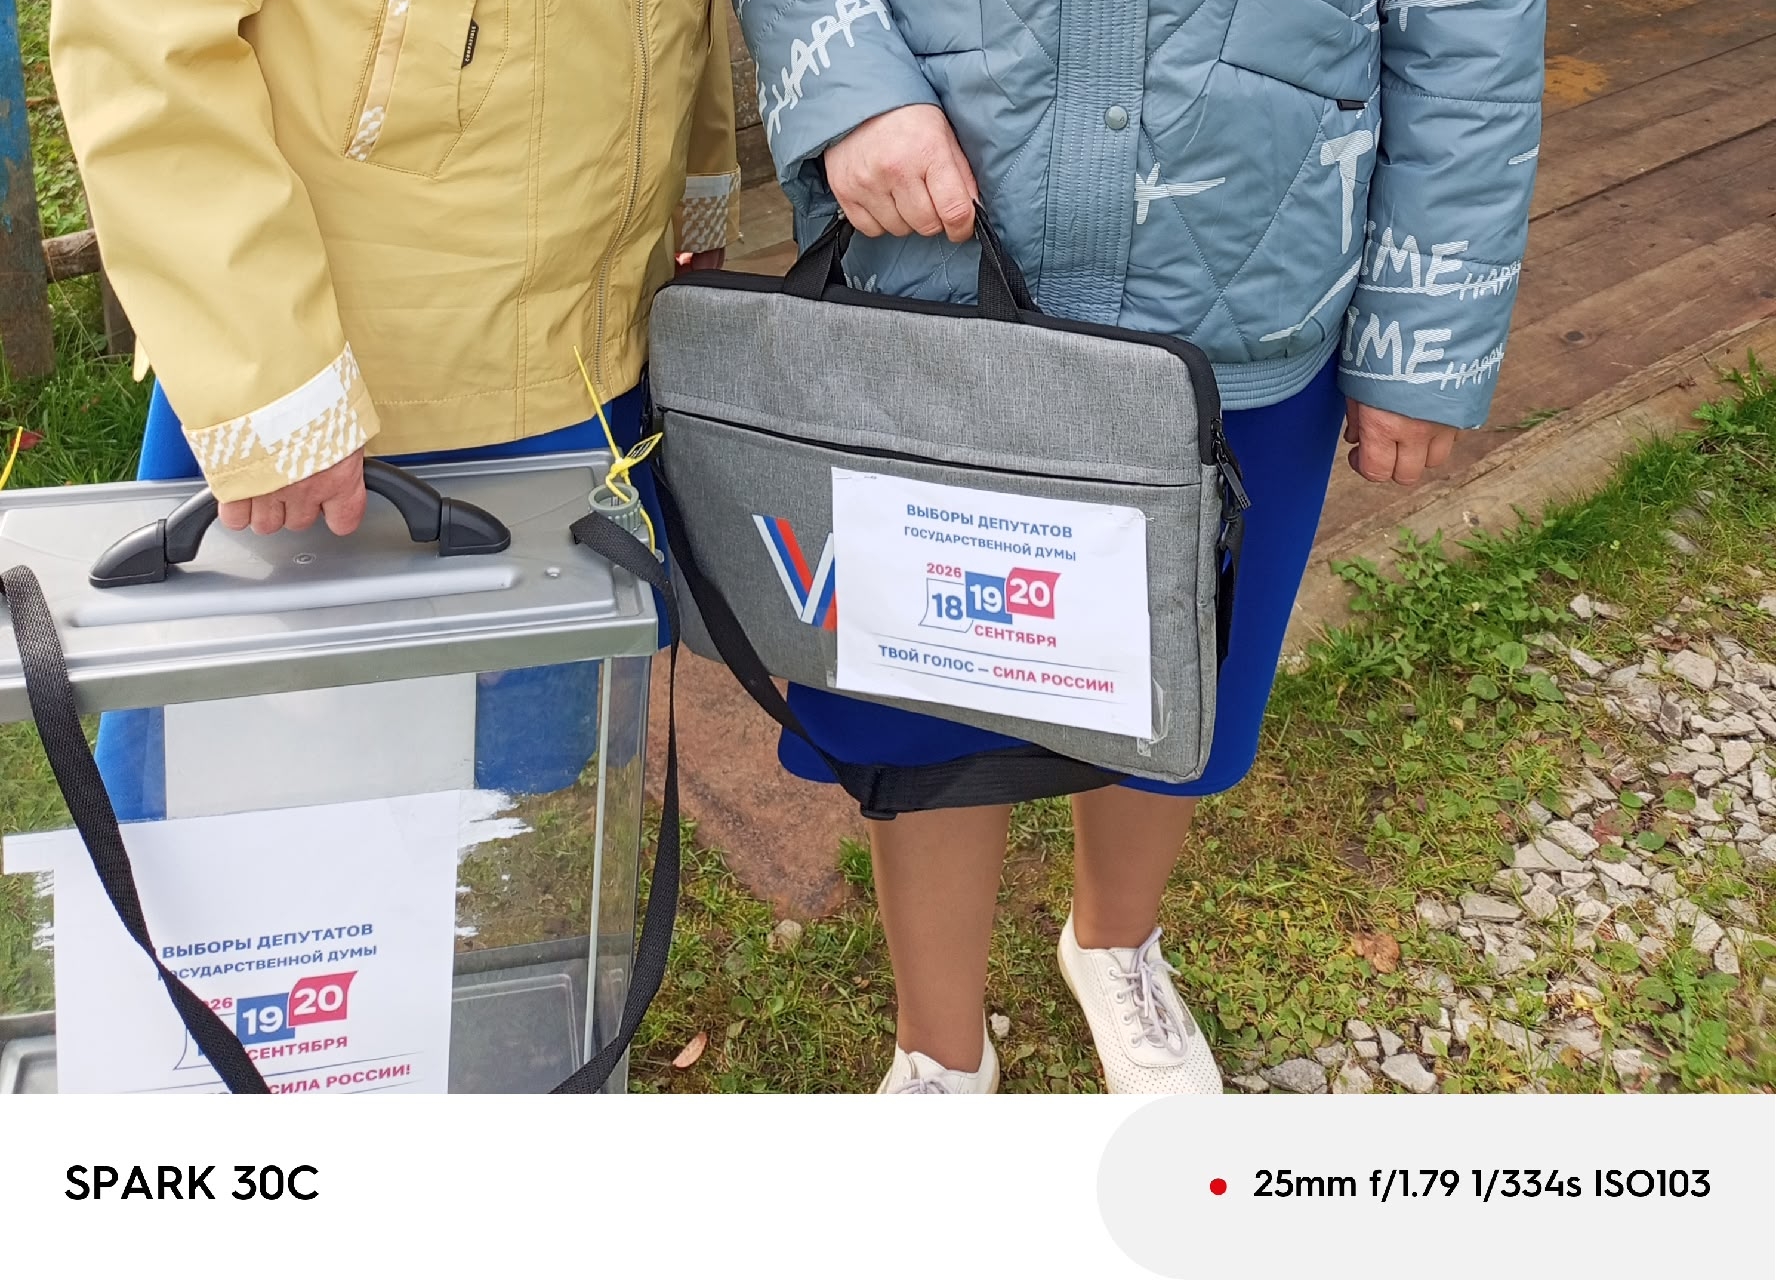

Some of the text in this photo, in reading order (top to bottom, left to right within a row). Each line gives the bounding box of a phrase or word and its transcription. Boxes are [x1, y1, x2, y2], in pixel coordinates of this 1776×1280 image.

[906, 504, 1073, 539] ВЫБОРЫ ДЕПУТАТОВ
[904, 526, 1077, 561] ГОСУДАРСТВЕННОЙ ДУМЫ
[926, 563, 962, 578] 2026
[931, 578, 1051, 621] 18 19 20
[974, 625, 1057, 648] СЕНТЯБРЯ
[878, 644, 919, 664] ТВОЙ
[923, 653, 975, 673] ГОЛОС
[993, 665, 1037, 683] СИЛА
[1041, 672, 1114, 694] РОССИИ!
[162, 923, 373, 959] ВЫБОРЫ ДЕПУТАТОВ
[327, 945, 377, 962] ДУМЫ
[242, 984, 344, 1036] 19 20
[249, 1036, 348, 1061] СЕНТЯБРЯ
[326, 1064, 412, 1089] РОССИИ!
